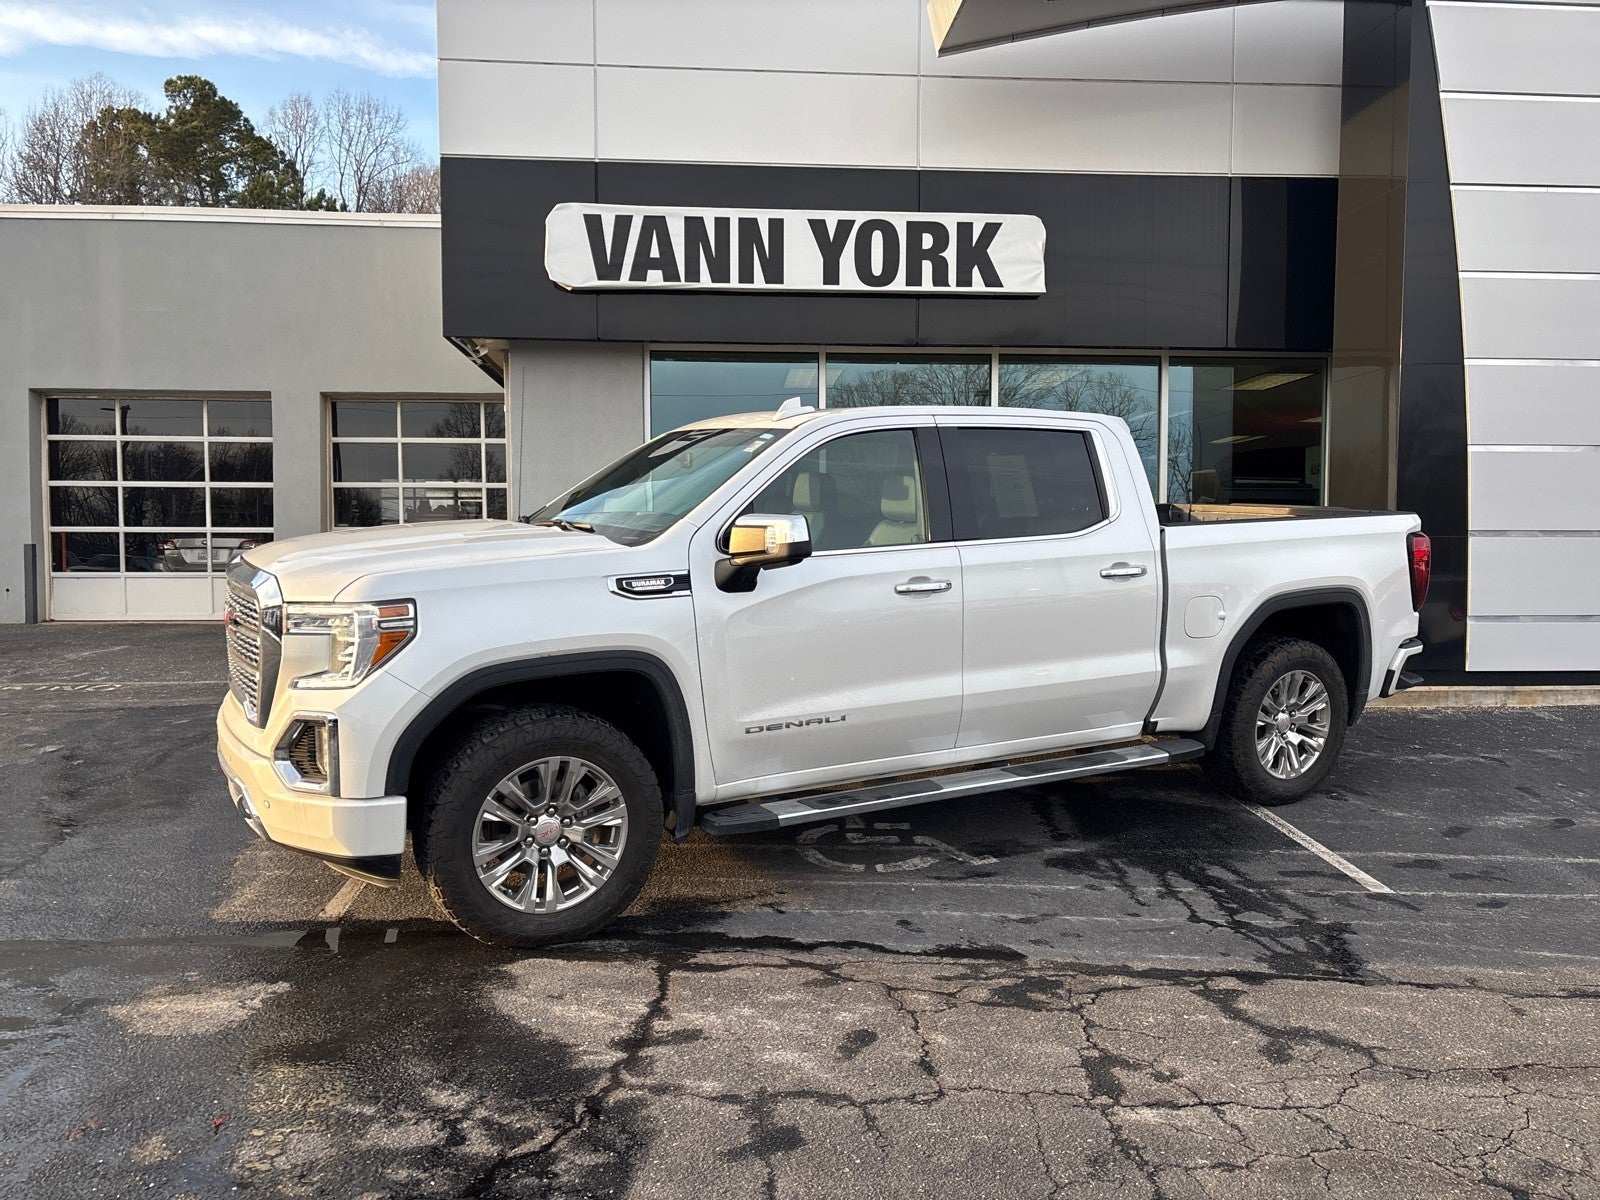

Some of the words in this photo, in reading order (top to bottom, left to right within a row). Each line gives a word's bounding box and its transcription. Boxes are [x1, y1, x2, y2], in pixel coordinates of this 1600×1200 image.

[582, 213, 785, 285] VANN
[806, 218, 1004, 288] YORK
[631, 579, 666, 588] DURAMAX
[745, 714, 847, 735] DENALI
